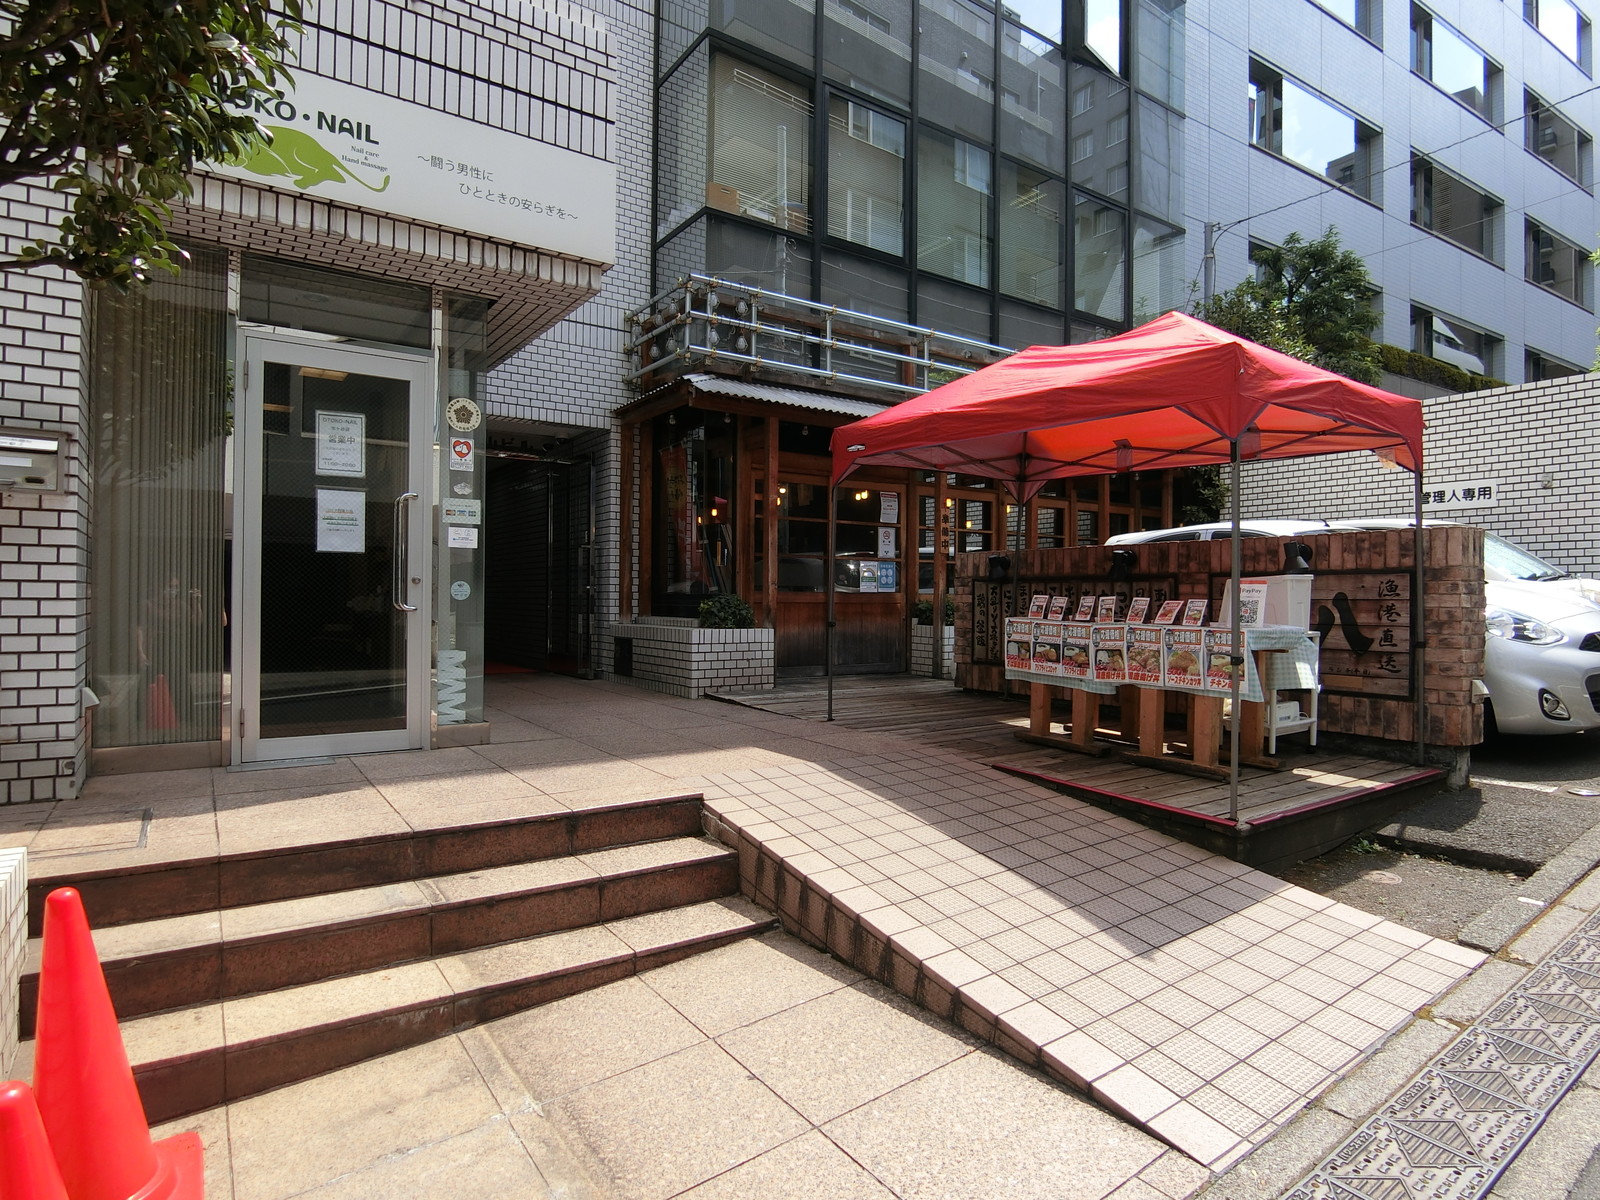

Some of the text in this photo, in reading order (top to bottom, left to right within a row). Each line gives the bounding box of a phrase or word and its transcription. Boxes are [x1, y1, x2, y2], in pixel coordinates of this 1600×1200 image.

[350, 145, 380, 158] Nail care
[341, 154, 388, 172] Hand massage
[1420, 486, 1492, 505] 管理人専用
[1378, 579, 1401, 673] 漁港直送
